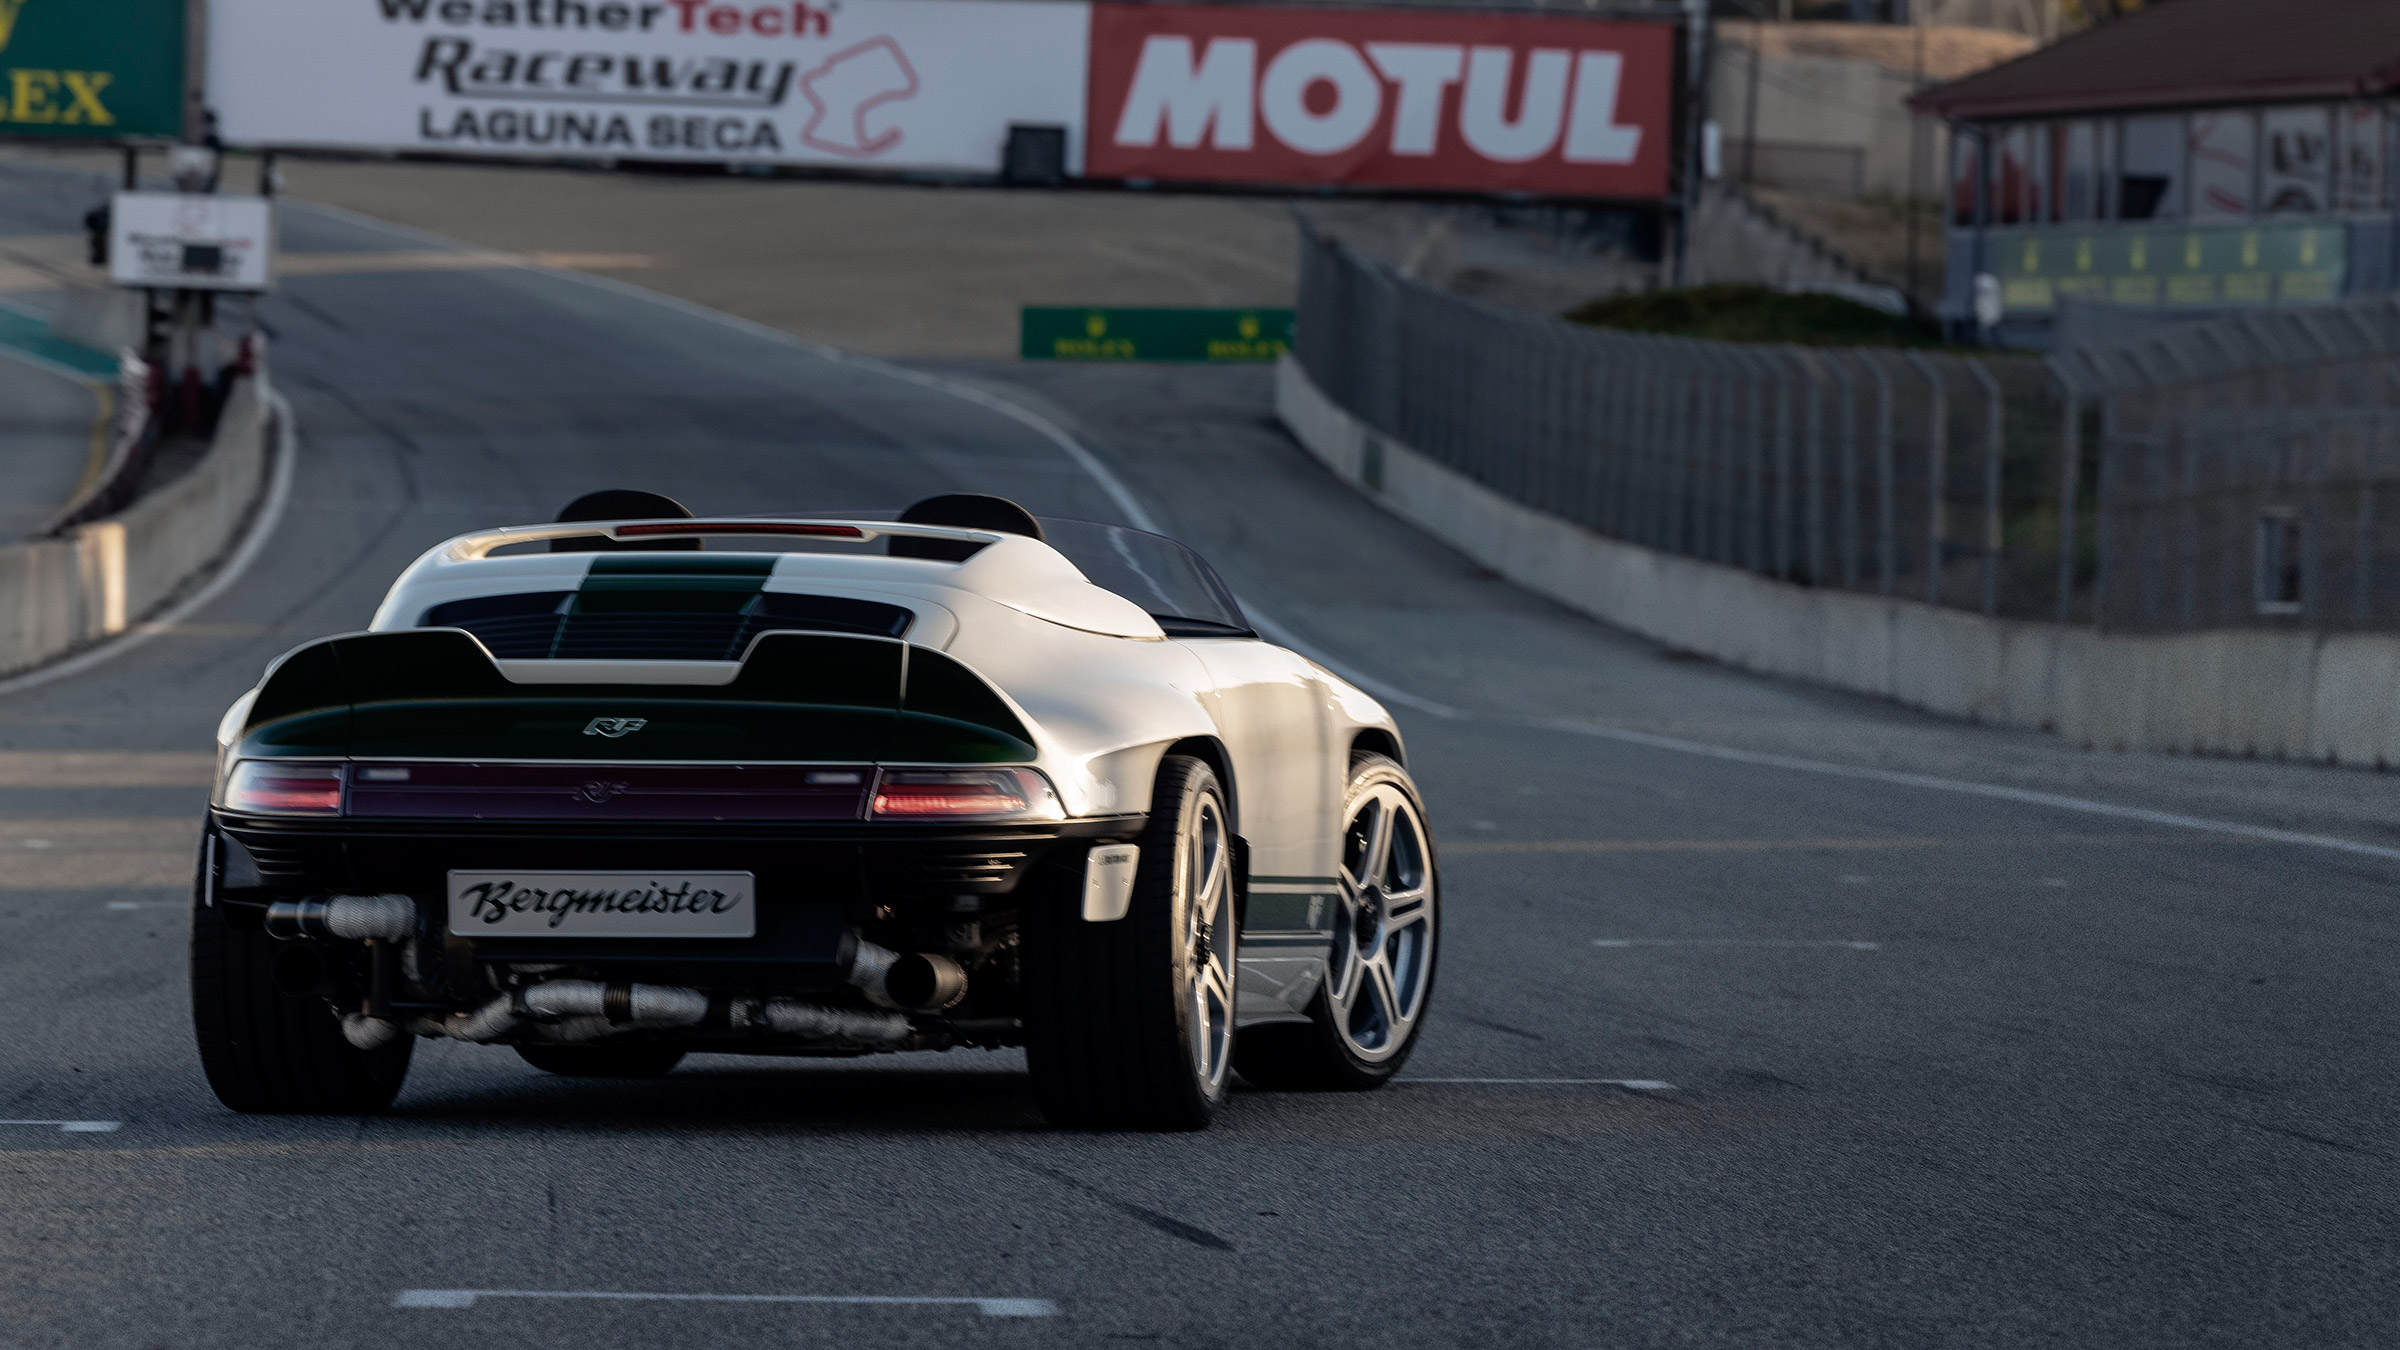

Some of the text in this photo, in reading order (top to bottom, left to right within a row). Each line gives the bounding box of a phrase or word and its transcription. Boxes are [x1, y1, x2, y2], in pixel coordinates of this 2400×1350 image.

[0, 68, 116, 126] EX
[413, 35, 796, 106] Raceway
[1114, 34, 1643, 165] MOTUL
[418, 107, 782, 151] LAGUNA SECA
[459, 880, 743, 928] Bergmeister
